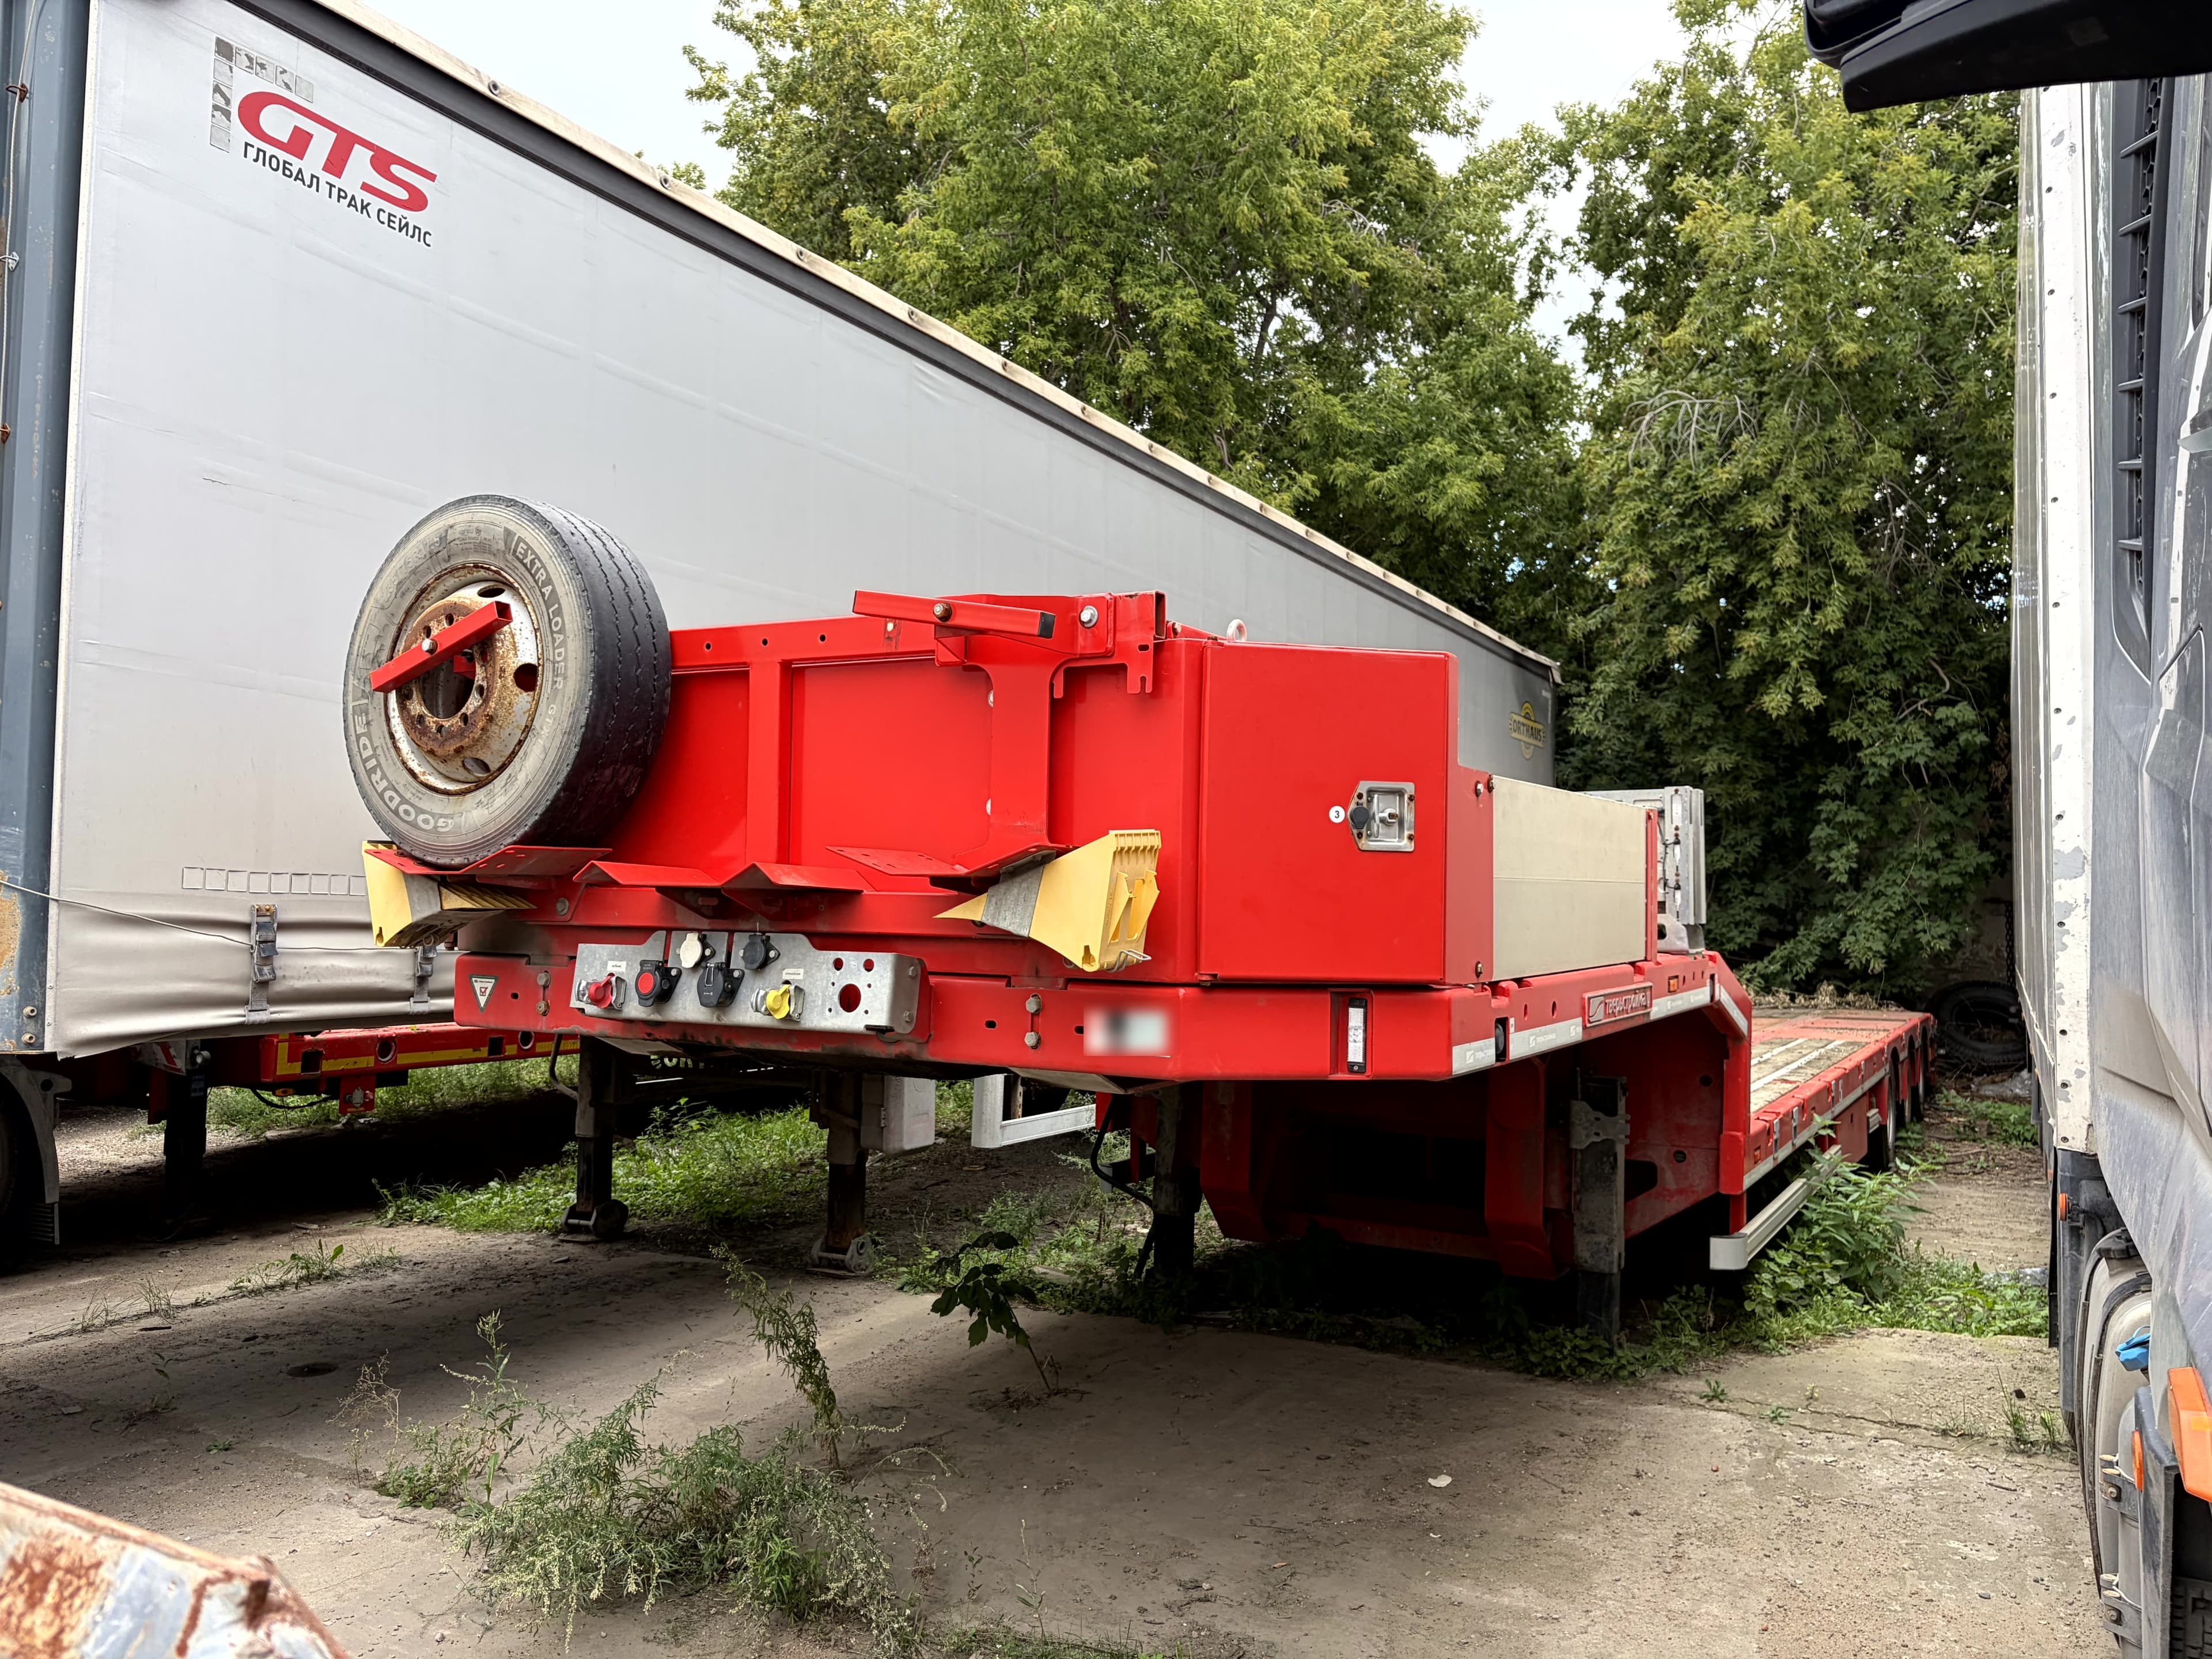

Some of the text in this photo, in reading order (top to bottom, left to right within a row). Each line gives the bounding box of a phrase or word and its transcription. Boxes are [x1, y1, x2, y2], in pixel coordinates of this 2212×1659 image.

[238, 91, 437, 213] GTS
[243, 141, 433, 248] ГЛОБАЛ ТРАК СЕЙЛС
[516, 541, 553, 600] EXTRA
[548, 603, 565, 691] LOADER
[355, 713, 454, 833] GOODRIDE
[1512, 719, 1542, 743] ORTHAUS
[1334, 810, 1340, 819] 3
